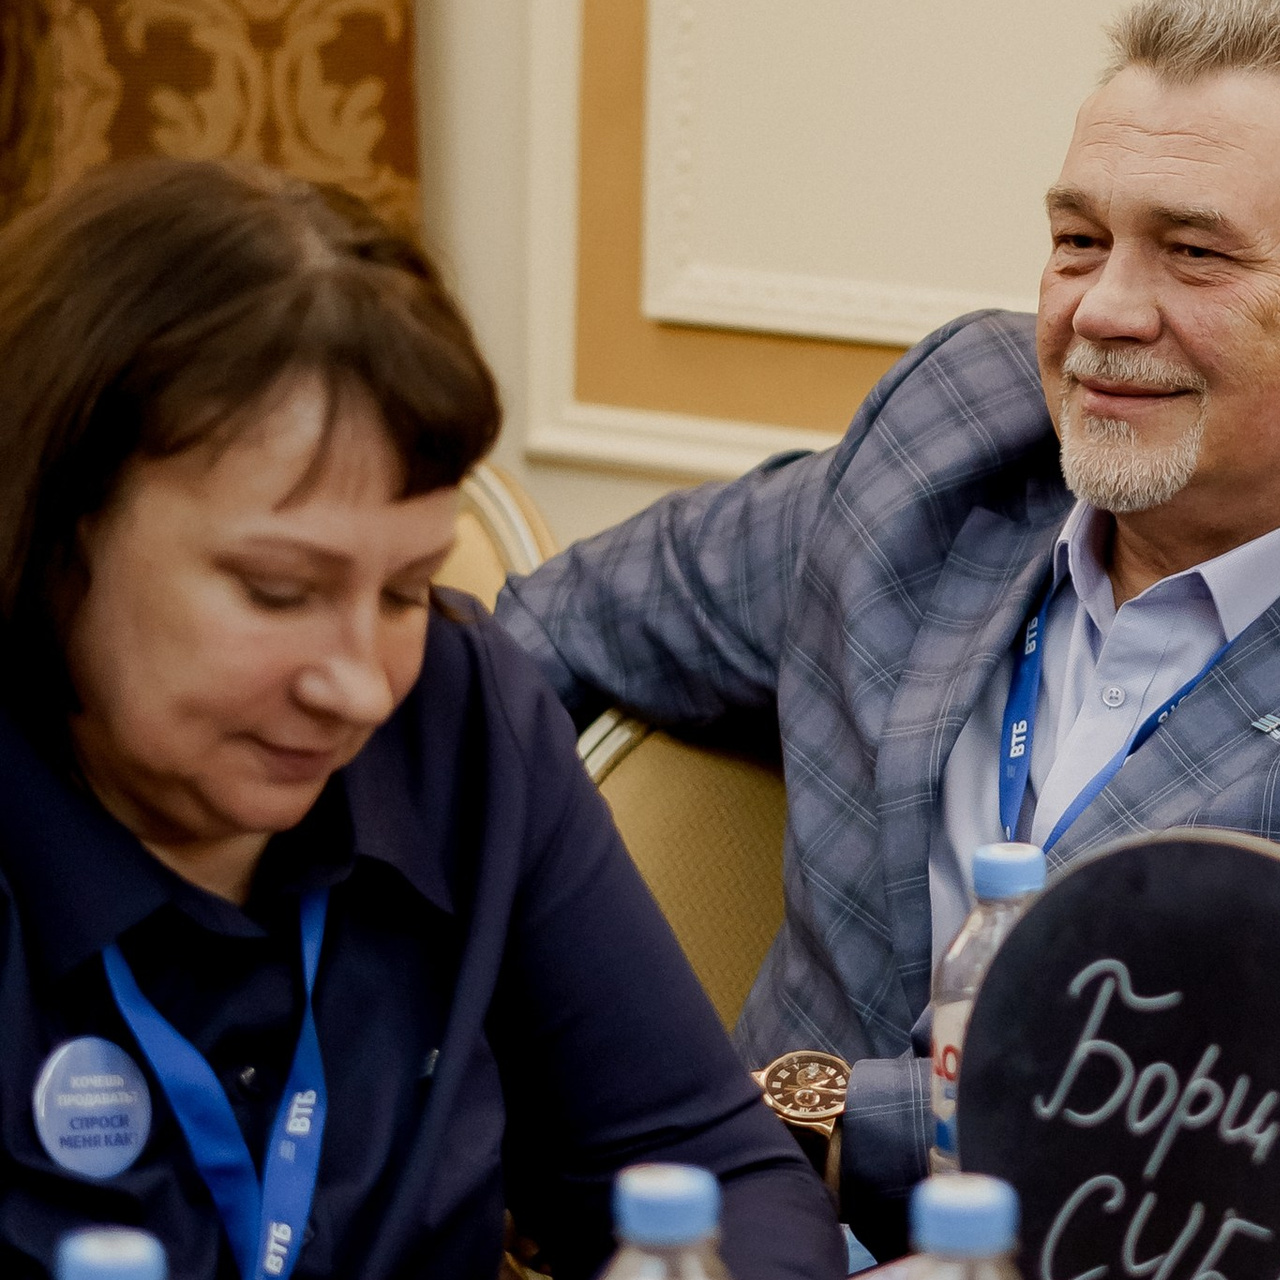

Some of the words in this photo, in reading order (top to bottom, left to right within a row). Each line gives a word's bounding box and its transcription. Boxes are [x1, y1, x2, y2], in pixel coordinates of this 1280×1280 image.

[1024, 616, 1039, 655] ВТБ
[1009, 719, 1028, 758] ВТБ
[69, 1114, 130, 1130] СПРОСИ
[285, 1089, 317, 1136] ВТБ
[59, 1135, 101, 1149] МЕНЯ
[264, 1221, 292, 1275] ВТБ
